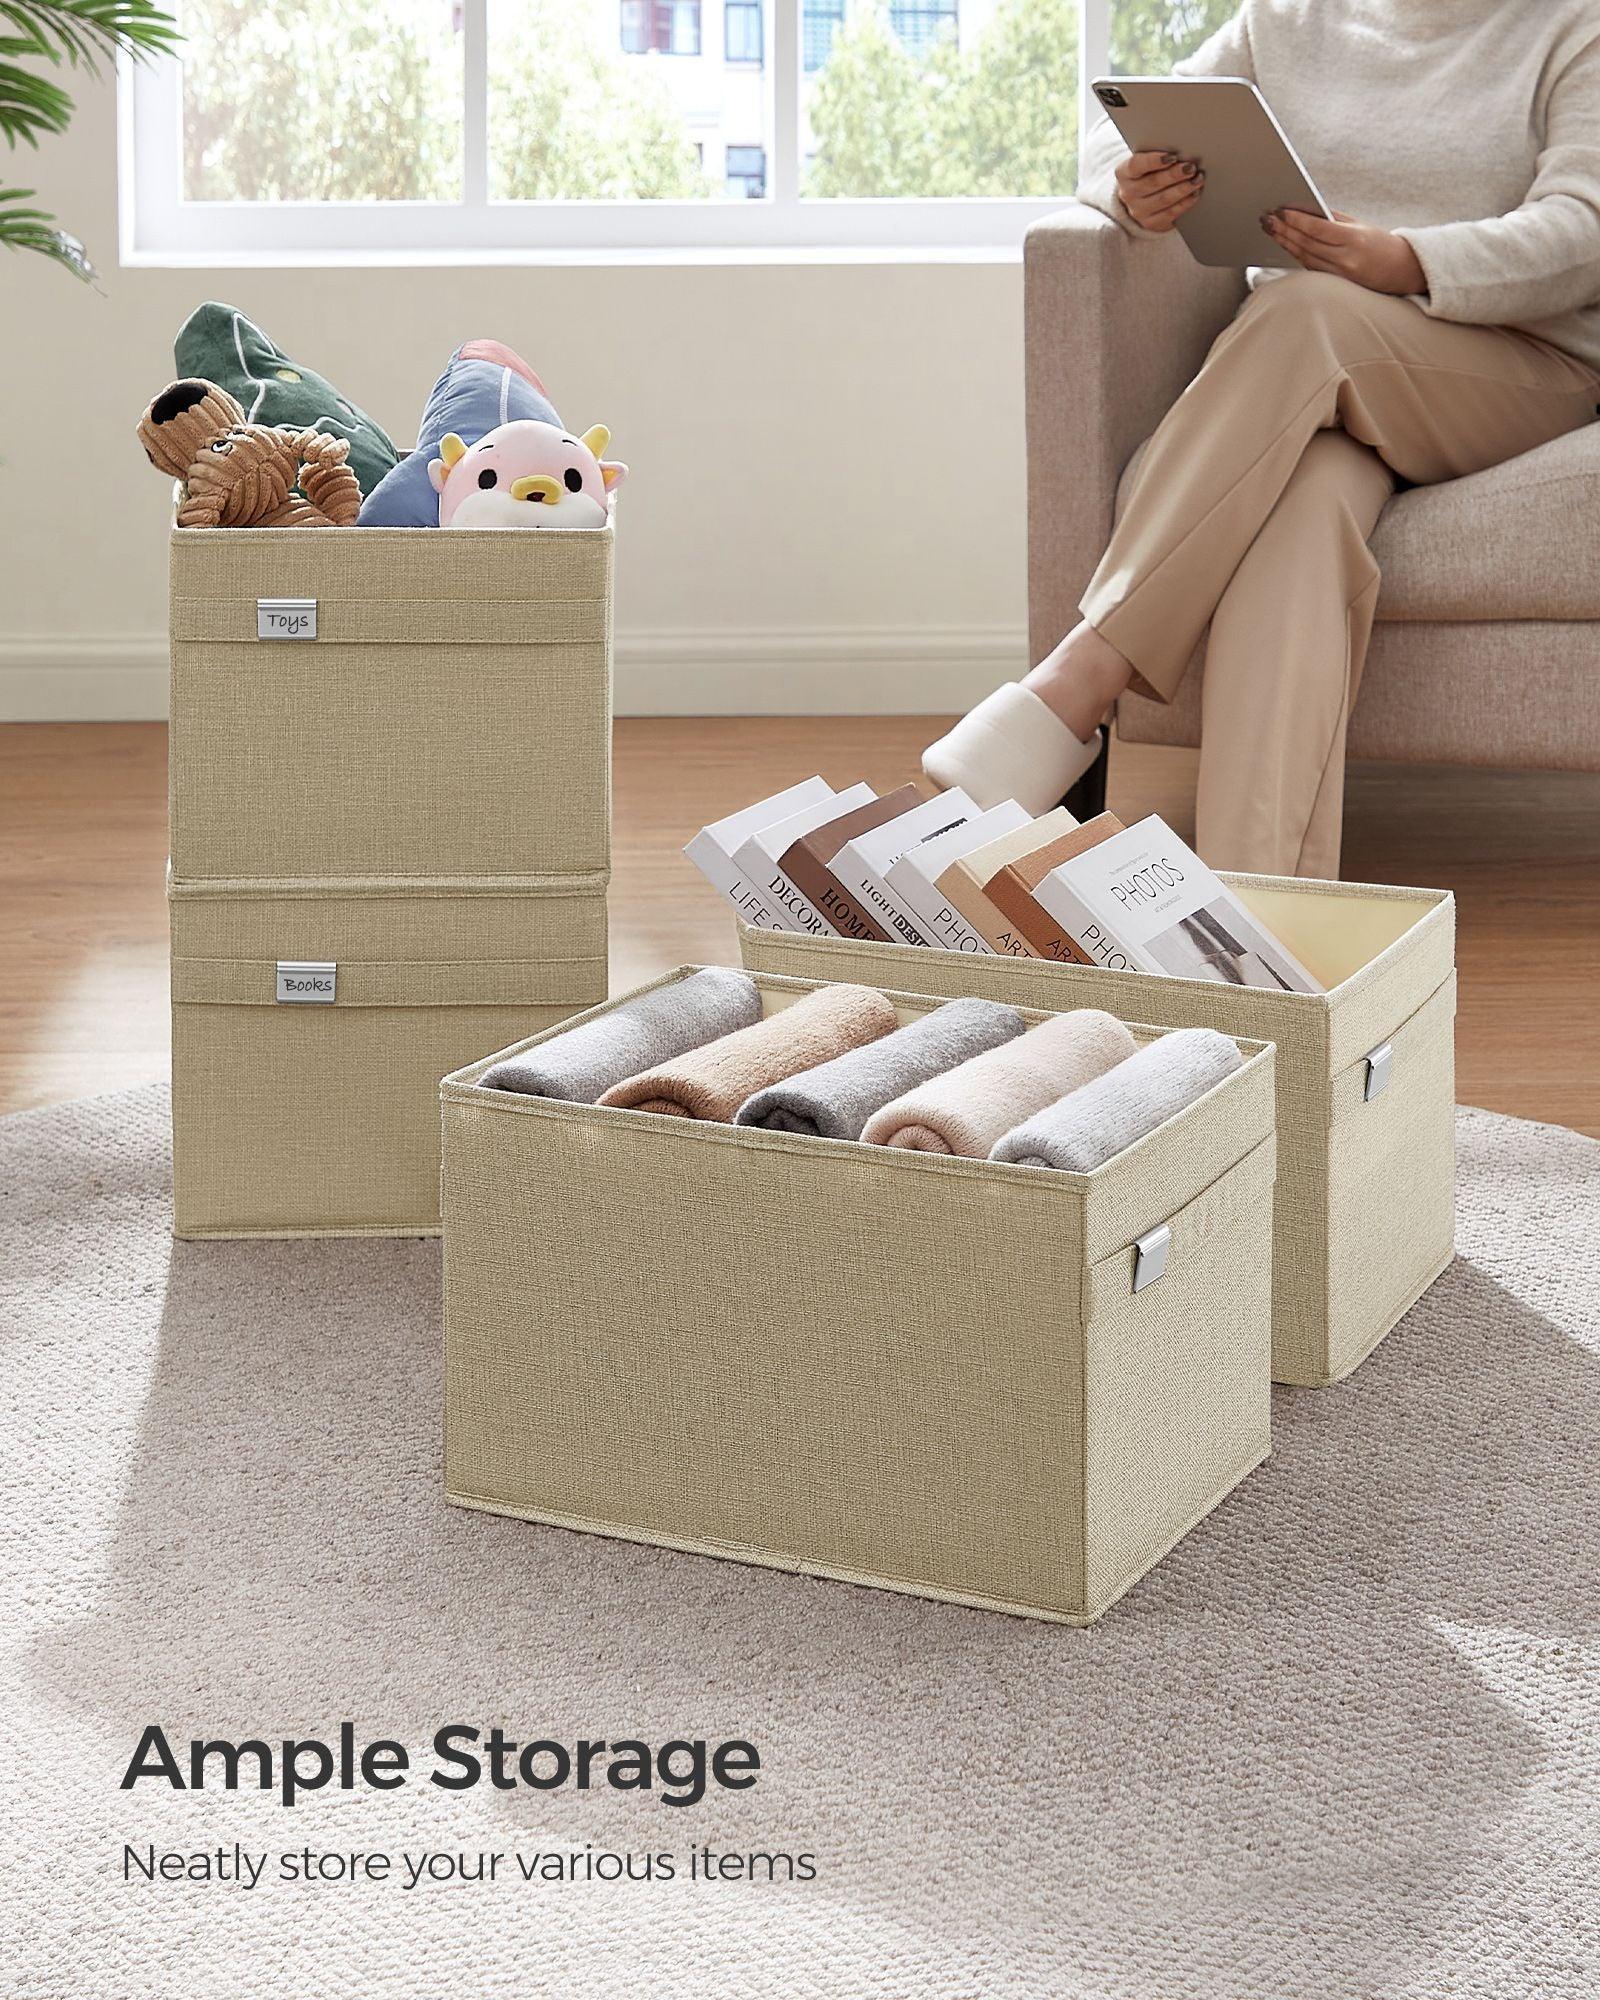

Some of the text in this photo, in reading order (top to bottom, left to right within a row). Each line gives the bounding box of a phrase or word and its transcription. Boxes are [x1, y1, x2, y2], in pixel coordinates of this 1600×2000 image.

[266, 614, 309, 635] Toys
[729, 881, 771, 926] LIFE
[860, 879, 898, 918] LIGHT
[1110, 857, 1185, 911] PHOTOS
[283, 977, 332, 992] Books
